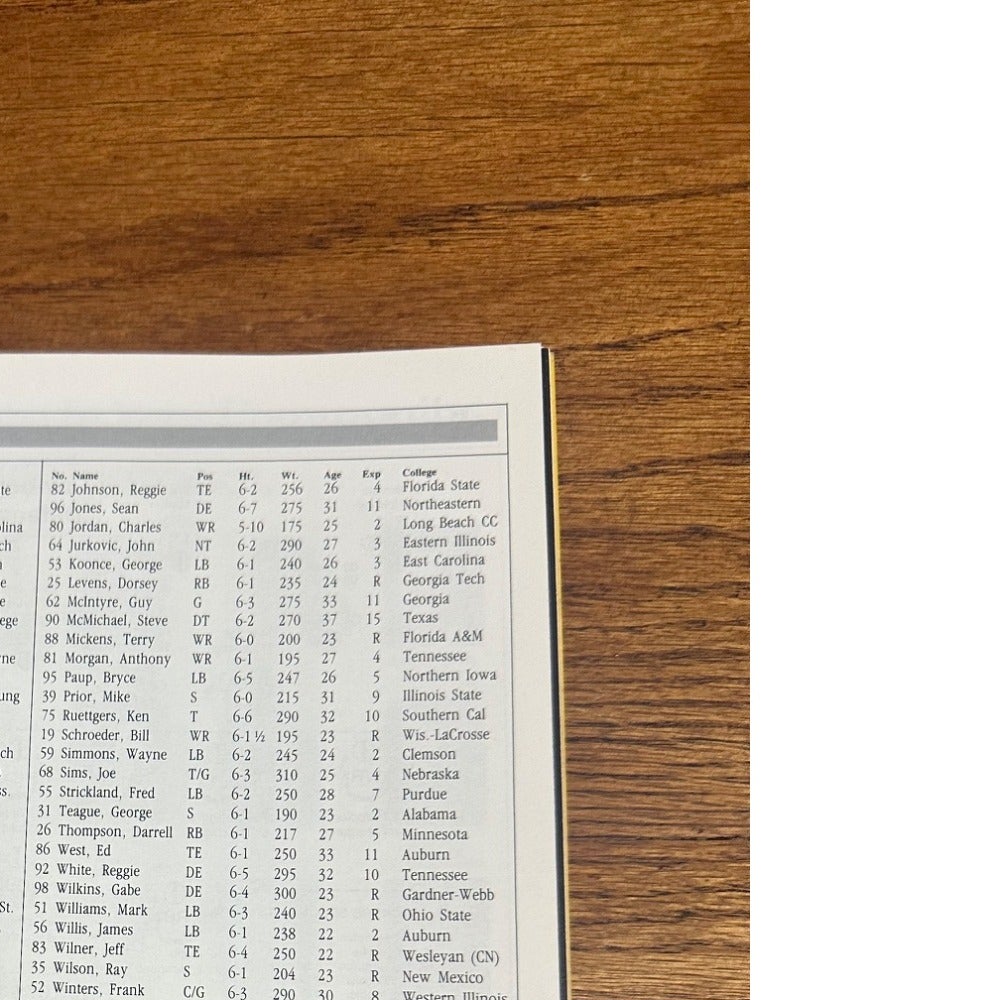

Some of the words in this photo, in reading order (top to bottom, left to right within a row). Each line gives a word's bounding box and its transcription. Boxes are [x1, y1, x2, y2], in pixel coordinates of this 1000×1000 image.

[51, 472, 67, 480] No.
[72, 472, 99, 480] Name
[196, 472, 213, 480] Pos
[238, 472, 253, 480] Ht.
[323, 471, 342, 480] Age
[362, 470, 381, 480] Exp
[402, 468, 437, 478] College
[50, 483, 65, 495] 82
[69, 483, 123, 498] Johnson,
[129, 484, 166, 499] Reggie
[195, 484, 211, 496] TE
[238, 483, 257, 496] 6-2
[280, 482, 303, 496] 256
[323, 481, 339, 494] 26
[402, 479, 445, 492] Florida
[449, 479, 480, 491] State
[43, 633, 59, 645] 88
[65, 632, 116, 646] Mickens,
[122, 633, 155, 649] Terry
[192, 634, 212, 646] WR
[234, 632, 254, 646] 6-0
[277, 633, 301, 646] 200
[321, 633, 336, 646] 23
[402, 630, 446, 643] Florida
[451, 630, 482, 642] A&M
[38, 785, 52, 797] 55
[58, 785, 122, 800] Strickland,
[129, 787, 155, 799] Fred
[187, 788, 203, 800] LB
[230, 786, 250, 800] 6-2
[275, 788, 298, 801] 250
[319, 788, 334, 801] 28
[402, 787, 447, 800] Purdue
[34, 862, 49, 876] 92
[56, 863, 95, 877] White,
[101, 864, 140, 880] Reggie
[185, 866, 202, 878] DE
[229, 865, 248, 880] 6-5
[273, 867, 296, 881] 295
[318, 868, 333, 882] 32
[364, 868, 379, 881] 10
[401, 868, 468, 881] Tennessee
[30, 981, 44, 993] 52
[51, 981, 102, 996] Winters,
[109, 983, 144, 996] Frank
[182, 985, 205, 998] C/G
[227, 985, 247, 1000] 6-3
